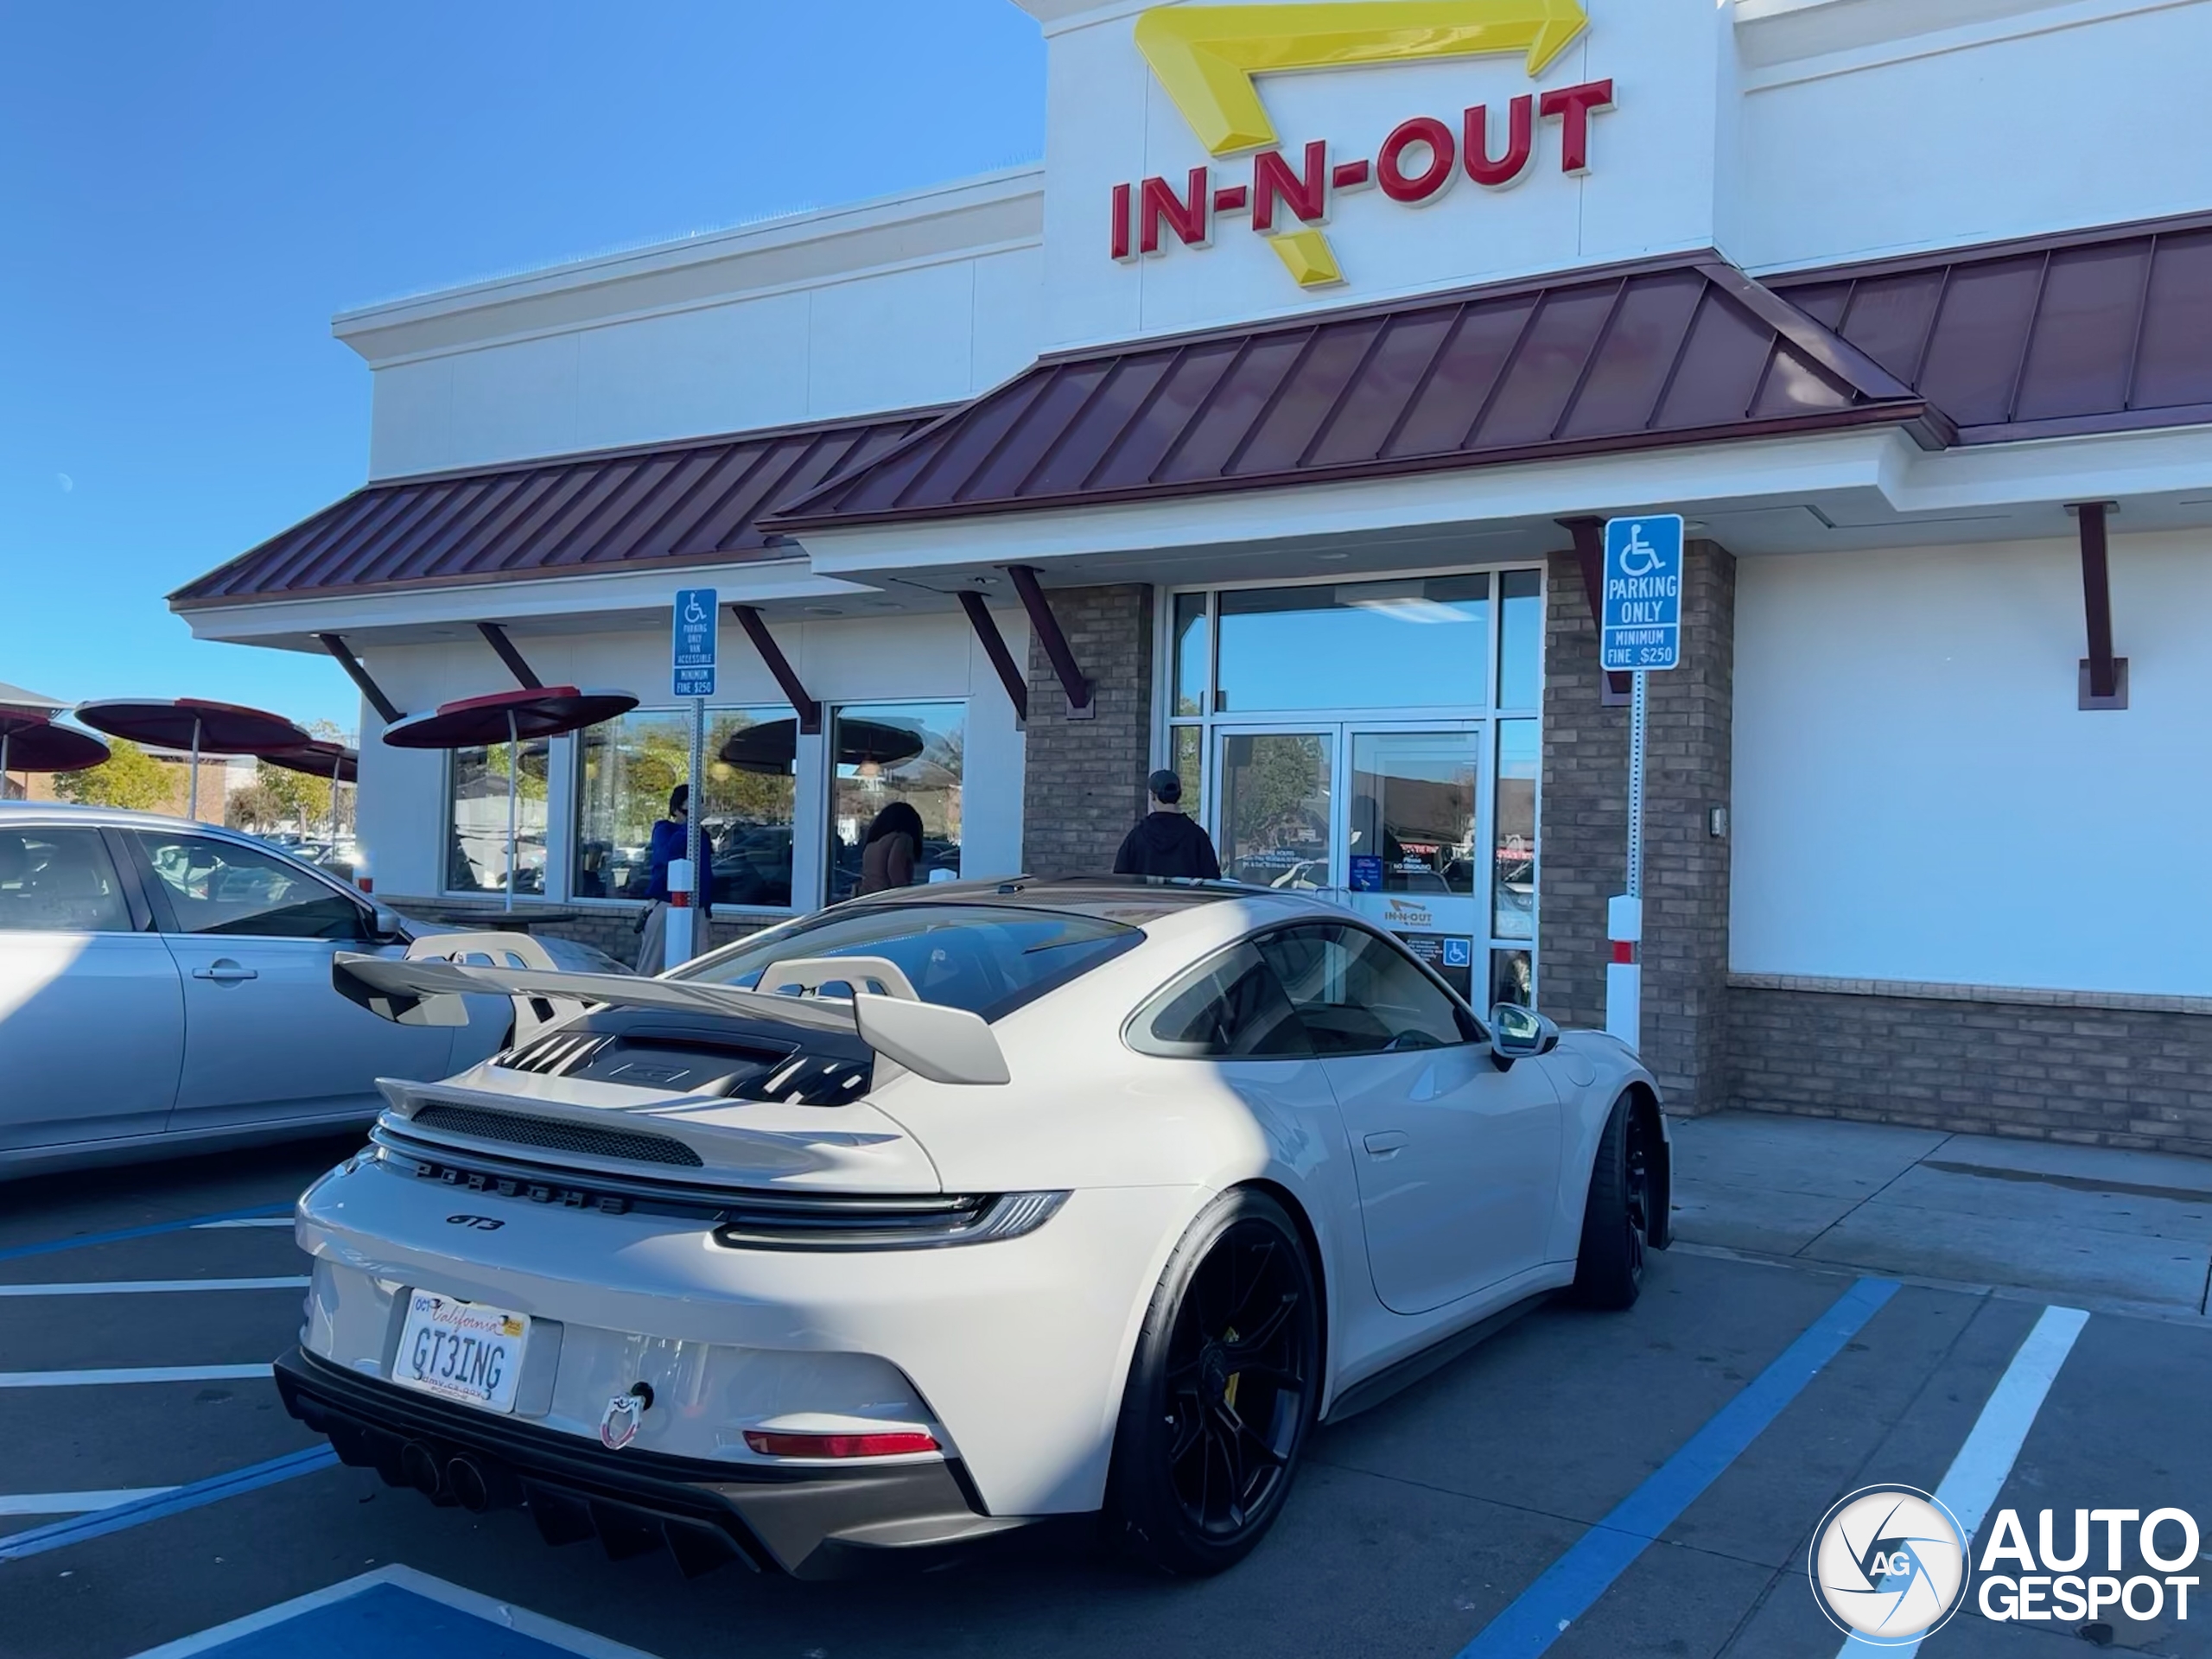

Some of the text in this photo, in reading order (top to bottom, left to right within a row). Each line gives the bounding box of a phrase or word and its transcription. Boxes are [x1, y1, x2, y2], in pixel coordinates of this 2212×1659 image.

[1111, 79, 1614, 261] IN-N-OUT
[1609, 575, 1676, 600] PARKING
[1621, 601, 1663, 623] ONLY
[683, 623, 707, 633] PARKING
[1615, 629, 1664, 645] MINIMUM
[688, 634, 702, 644] ONLY
[1607, 646, 1673, 664] FINE $250
[681, 670, 709, 680] MINIMUM
[677, 681, 712, 693] FINE $250
[1384, 912, 1432, 922] IN-N-OUT
[416, 1162, 624, 1214] PORSCHE
[446, 1215, 505, 1230] GT3
[431, 1302, 505, 1336] California
[412, 1327, 504, 1389] GT3ING
[422, 1376, 482, 1397] dmv.ca.gov
